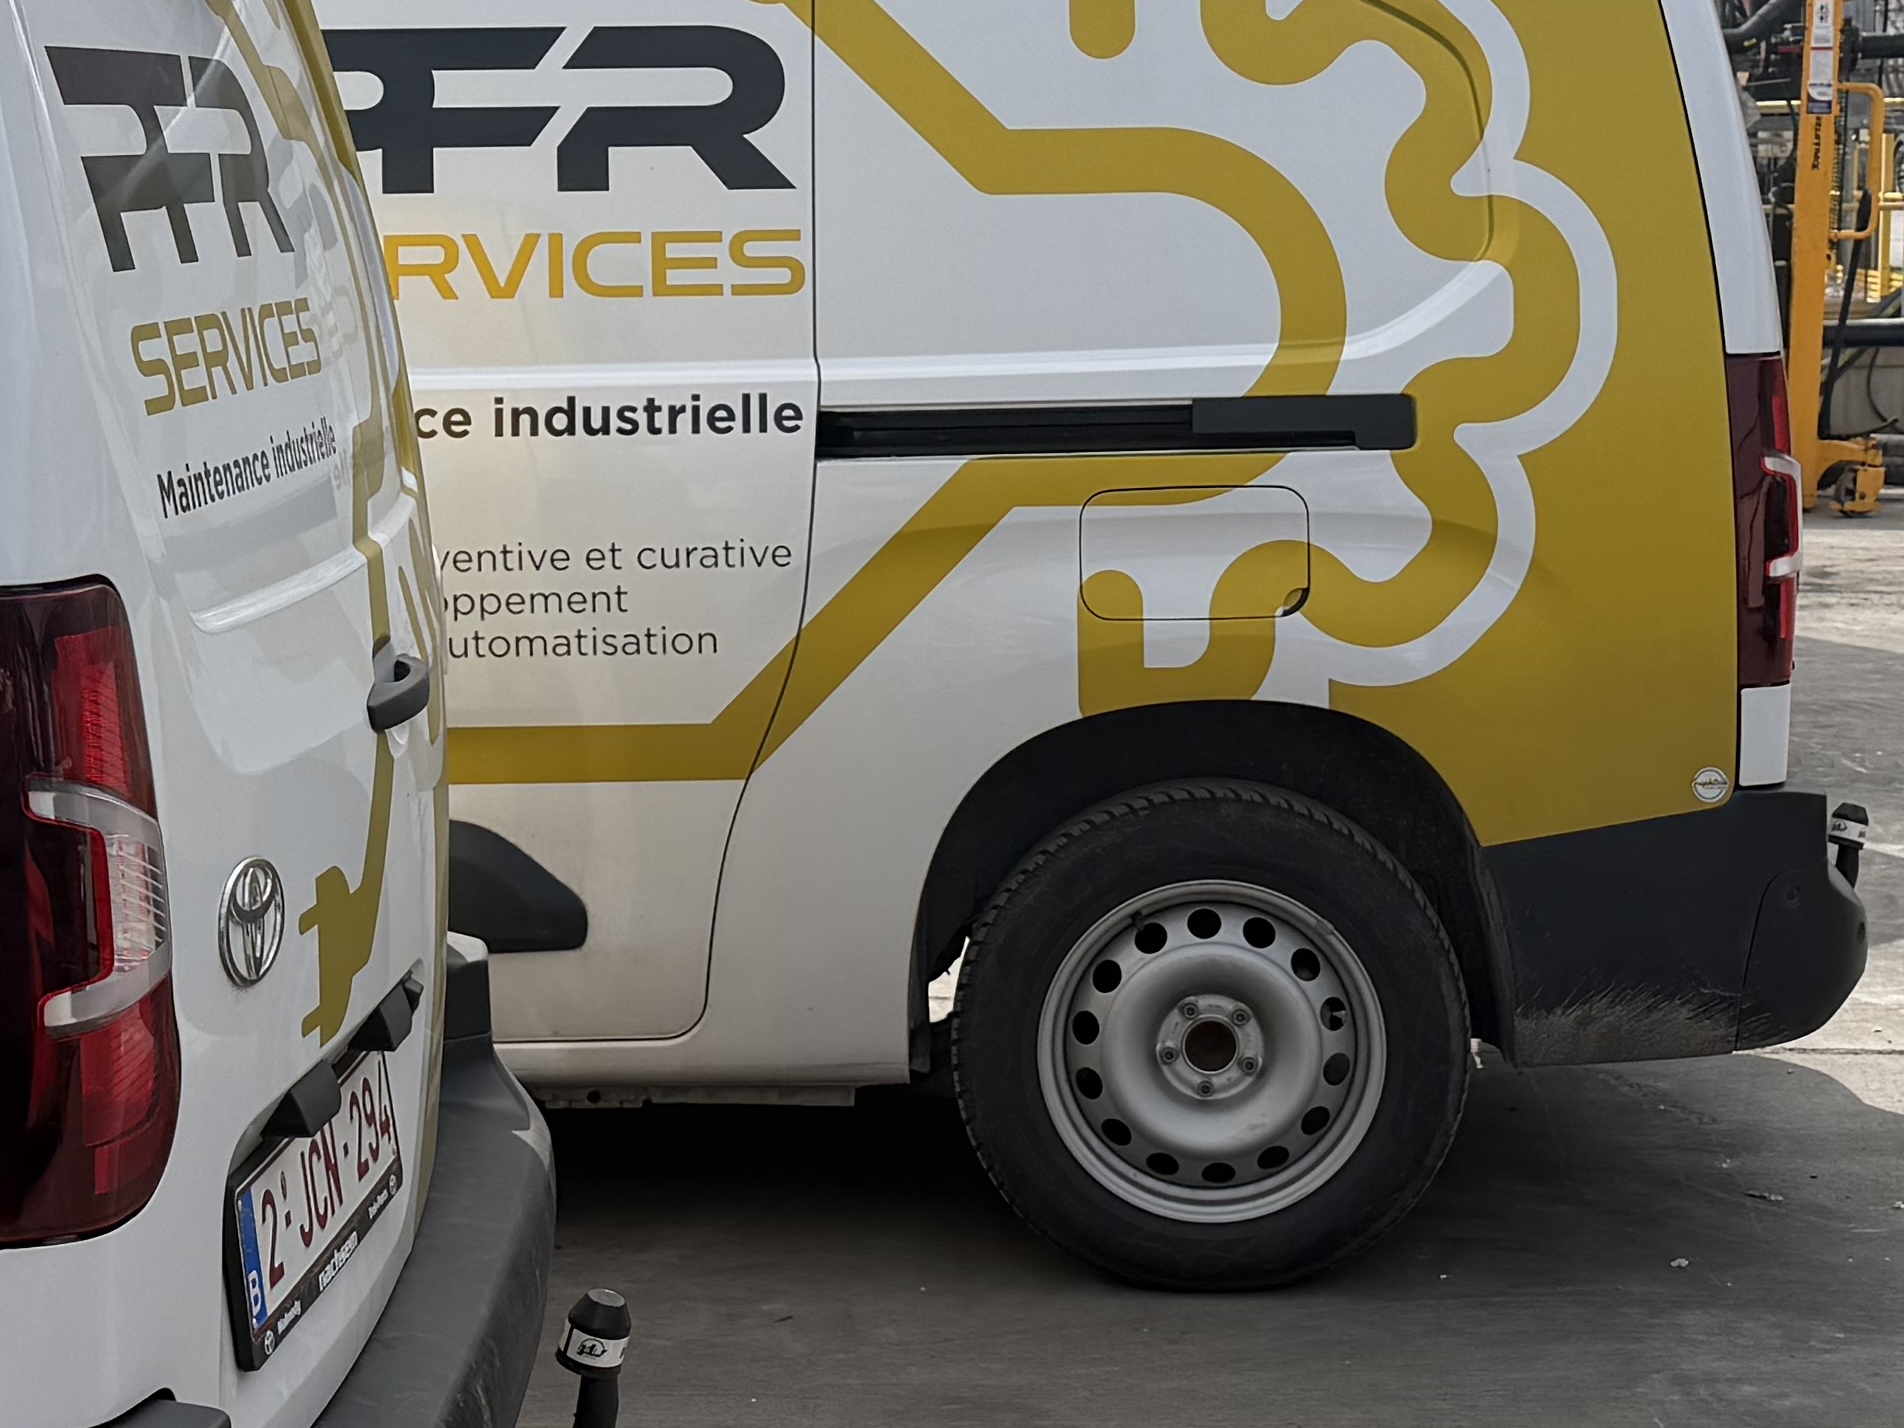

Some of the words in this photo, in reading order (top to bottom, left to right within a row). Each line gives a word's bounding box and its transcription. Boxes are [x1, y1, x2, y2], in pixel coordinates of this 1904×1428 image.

[44, 46, 295, 272] PFR
[383, 229, 807, 301] RVICES
[131, 298, 323, 416] SERVICES
[494, 393, 804, 438] industrielle
[157, 449, 271, 519] Maintenance
[272, 416, 338, 482] industrielle
[440, 541, 570, 573] ventive
[585, 542, 622, 571] et
[637, 538, 792, 570] curative
[443, 585, 628, 622] ppement
[448, 626, 718, 659] utomatisation
[248, 1270, 262, 1316] B
